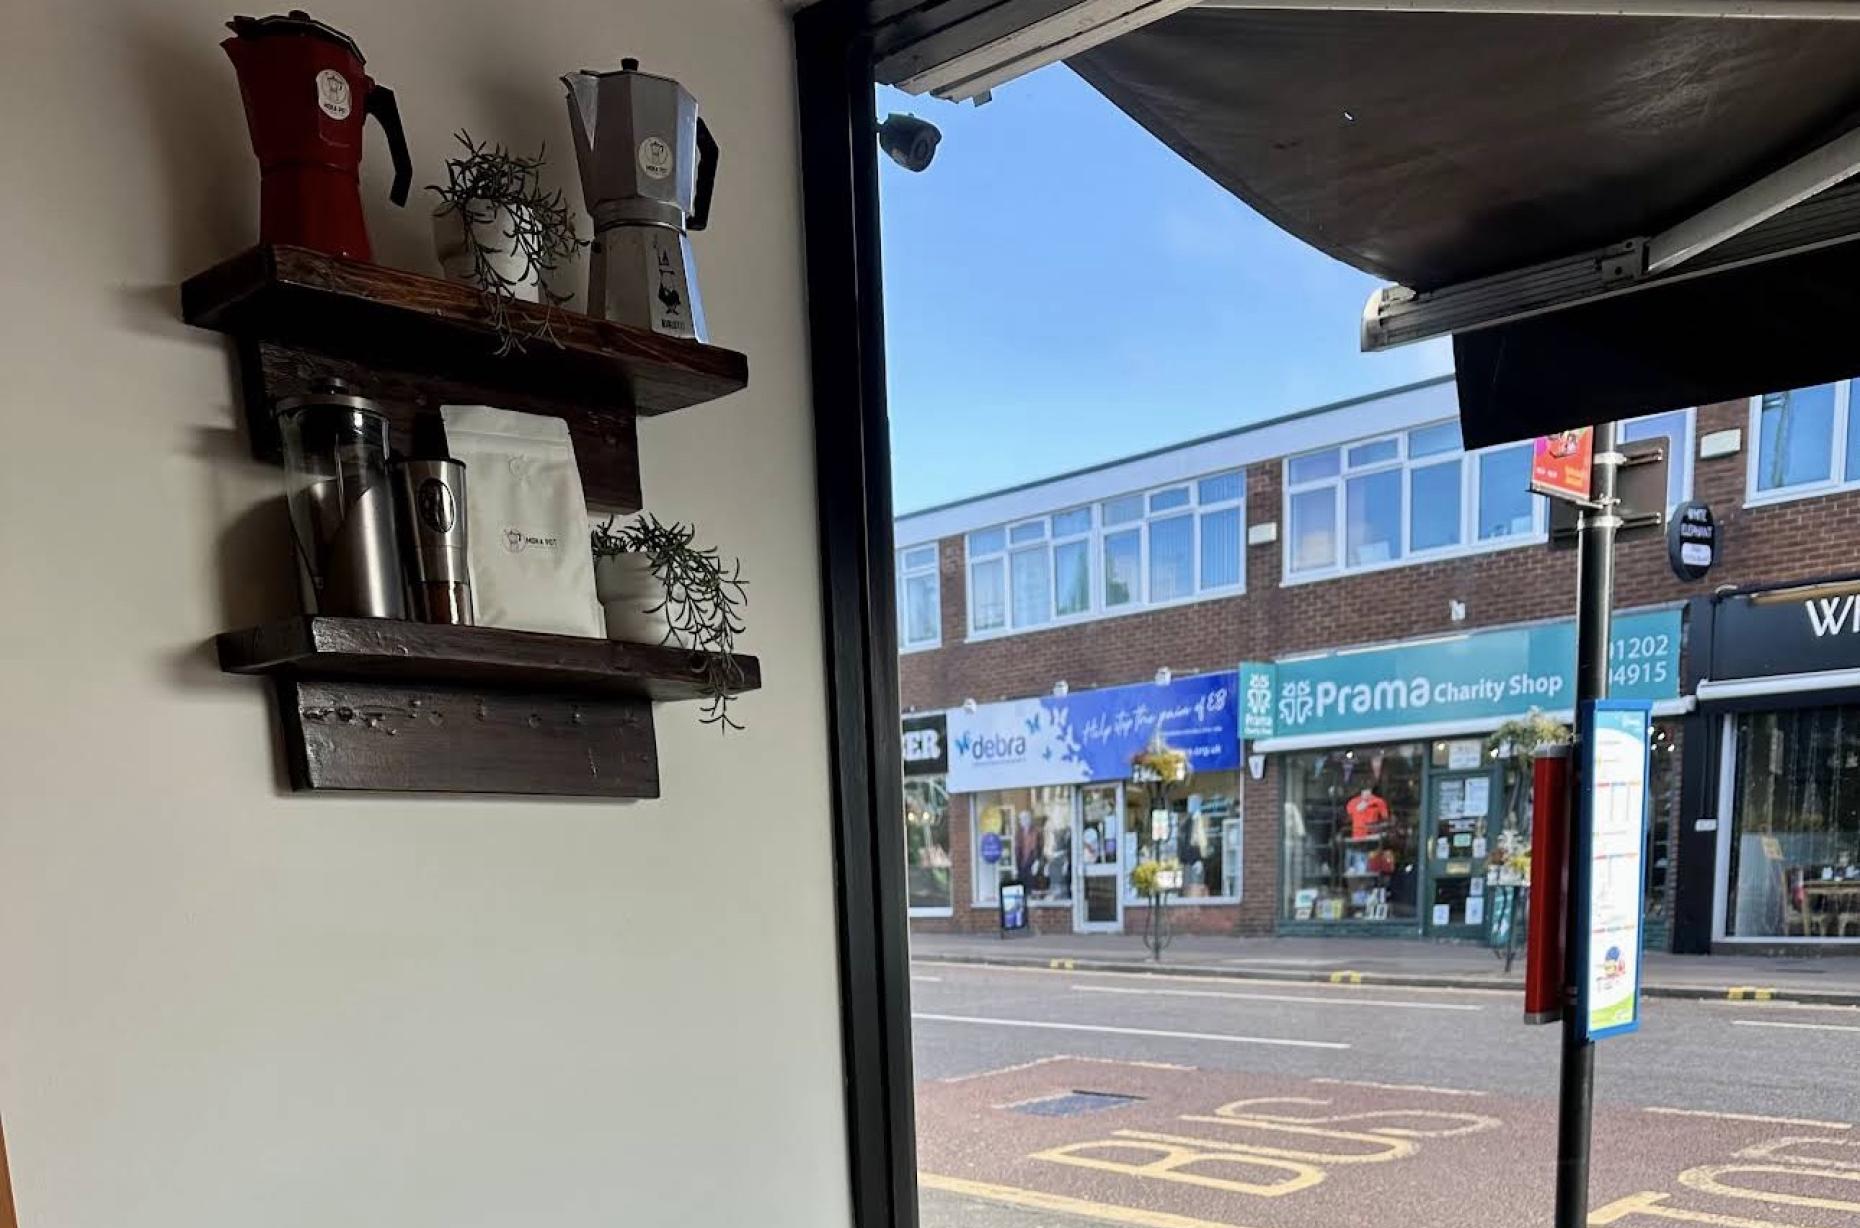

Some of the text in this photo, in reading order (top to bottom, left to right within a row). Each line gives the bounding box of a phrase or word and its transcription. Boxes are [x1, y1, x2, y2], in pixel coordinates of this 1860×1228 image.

[1608, 661, 1668, 686] 4915
[1315, 673, 1564, 718] Prama Charity Shop
[902, 730, 941, 760] ER
[972, 733, 1026, 760] debra
[1026, 1097, 1502, 1198] BUS
